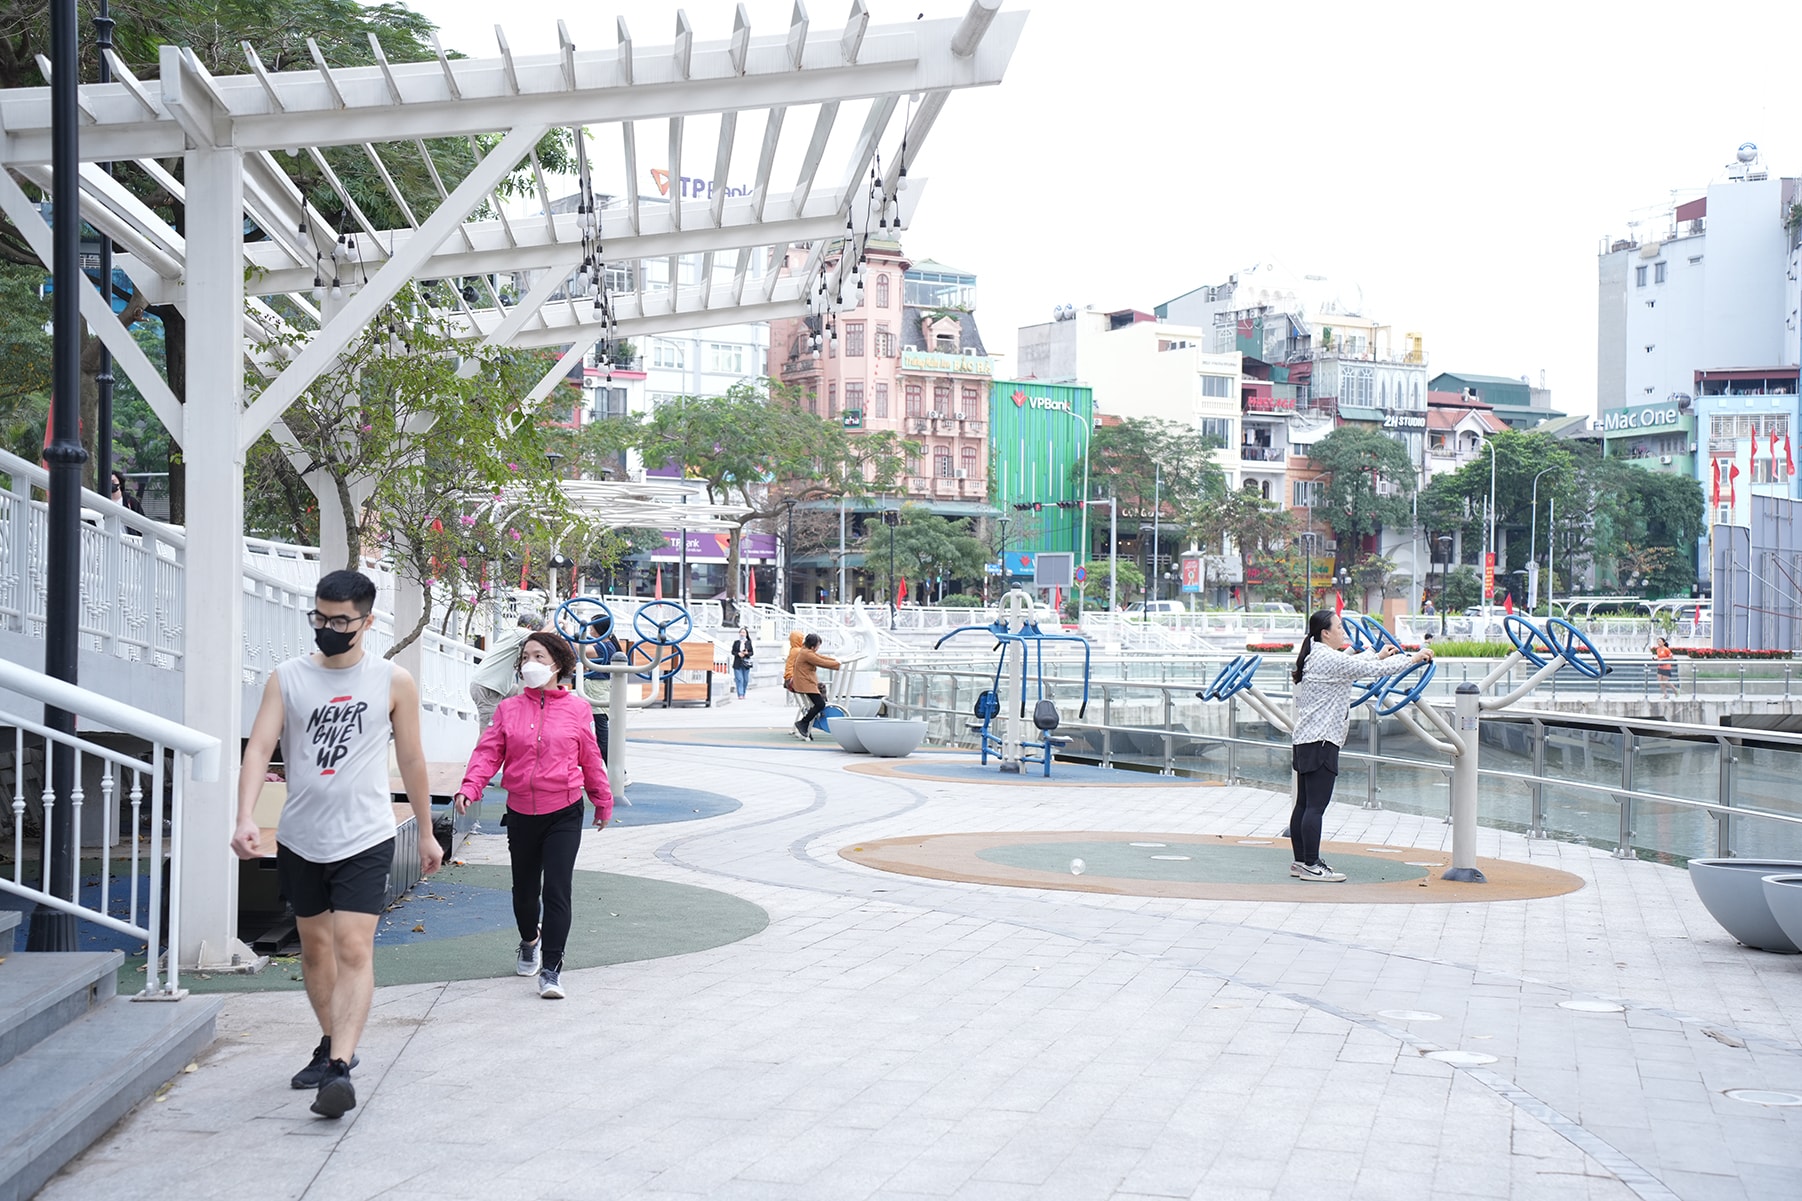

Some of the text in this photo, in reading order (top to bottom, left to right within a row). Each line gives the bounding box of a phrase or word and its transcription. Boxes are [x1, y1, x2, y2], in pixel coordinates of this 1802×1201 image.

[1029, 396, 1072, 411] VPBank
[1247, 396, 1296, 409] MASSAGE
[844, 416, 860, 425] aha
[1383, 415, 1426, 427] 2H STUDIO
[1640, 408, 1676, 426] One
[670, 537, 700, 548] TPank
[306, 701, 368, 735] NEVER
[312, 724, 356, 748] GIVE
[316, 744, 348, 769] UP
